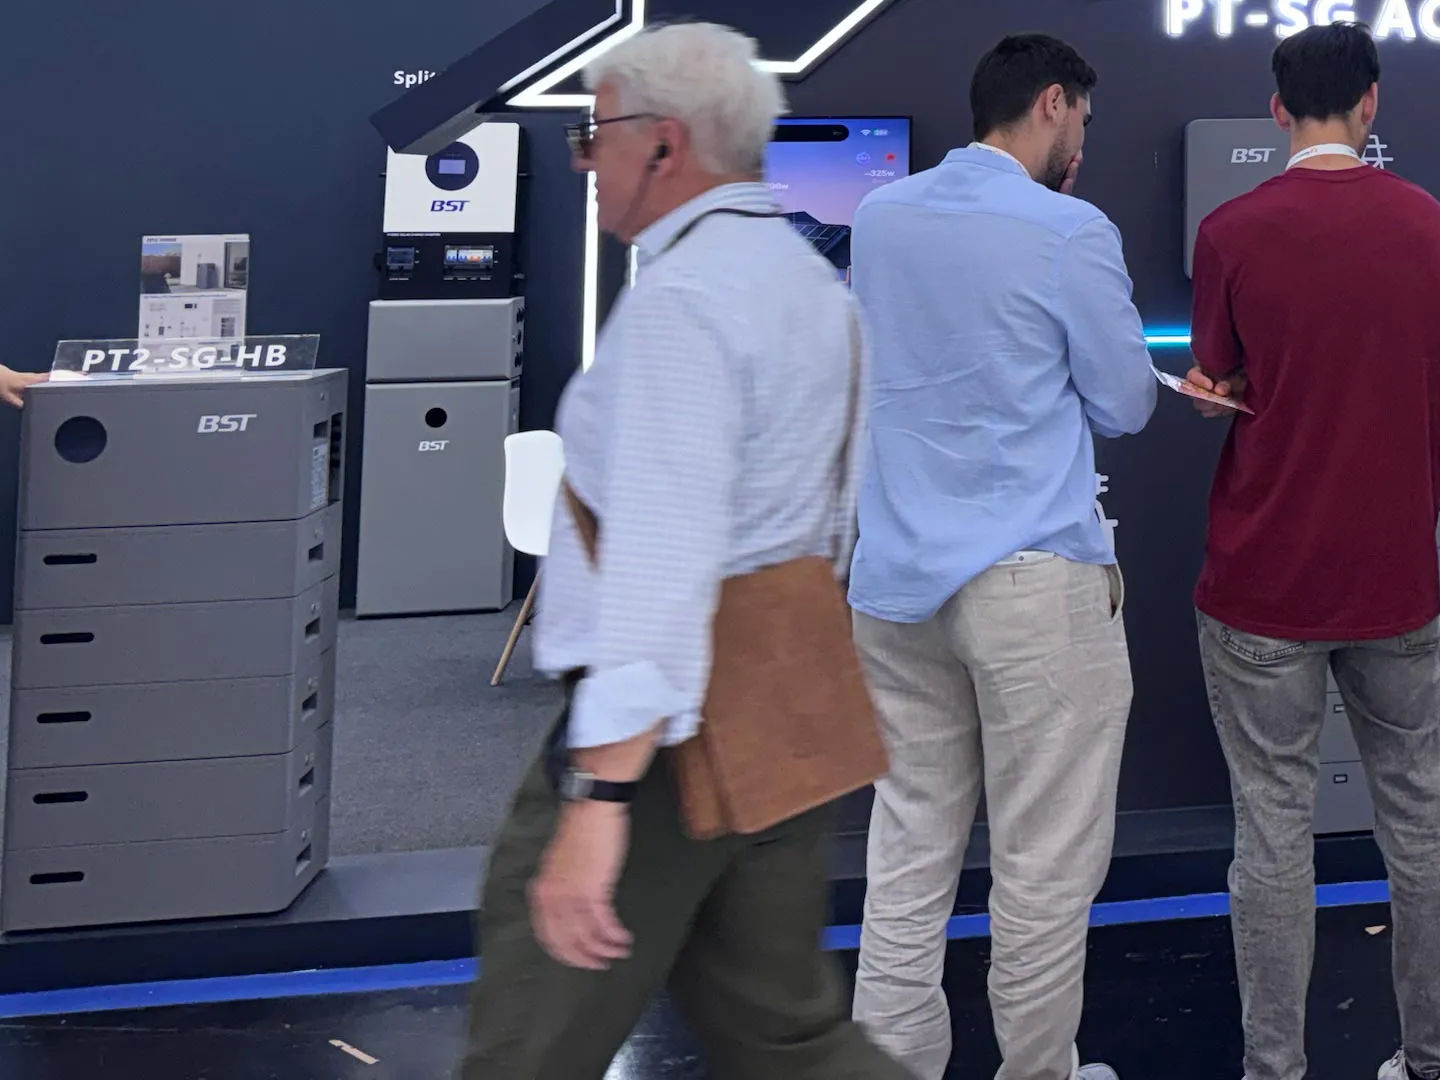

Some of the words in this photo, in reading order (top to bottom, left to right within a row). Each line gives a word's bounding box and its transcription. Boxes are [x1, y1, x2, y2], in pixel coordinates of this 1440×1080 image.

[393, 69, 436, 89] Spli
[1230, 147, 1276, 163] BST
[430, 199, 471, 212] BST
[81, 344, 287, 372] PT2-SG-HB
[197, 414, 258, 433] BST
[418, 439, 450, 452] BST
